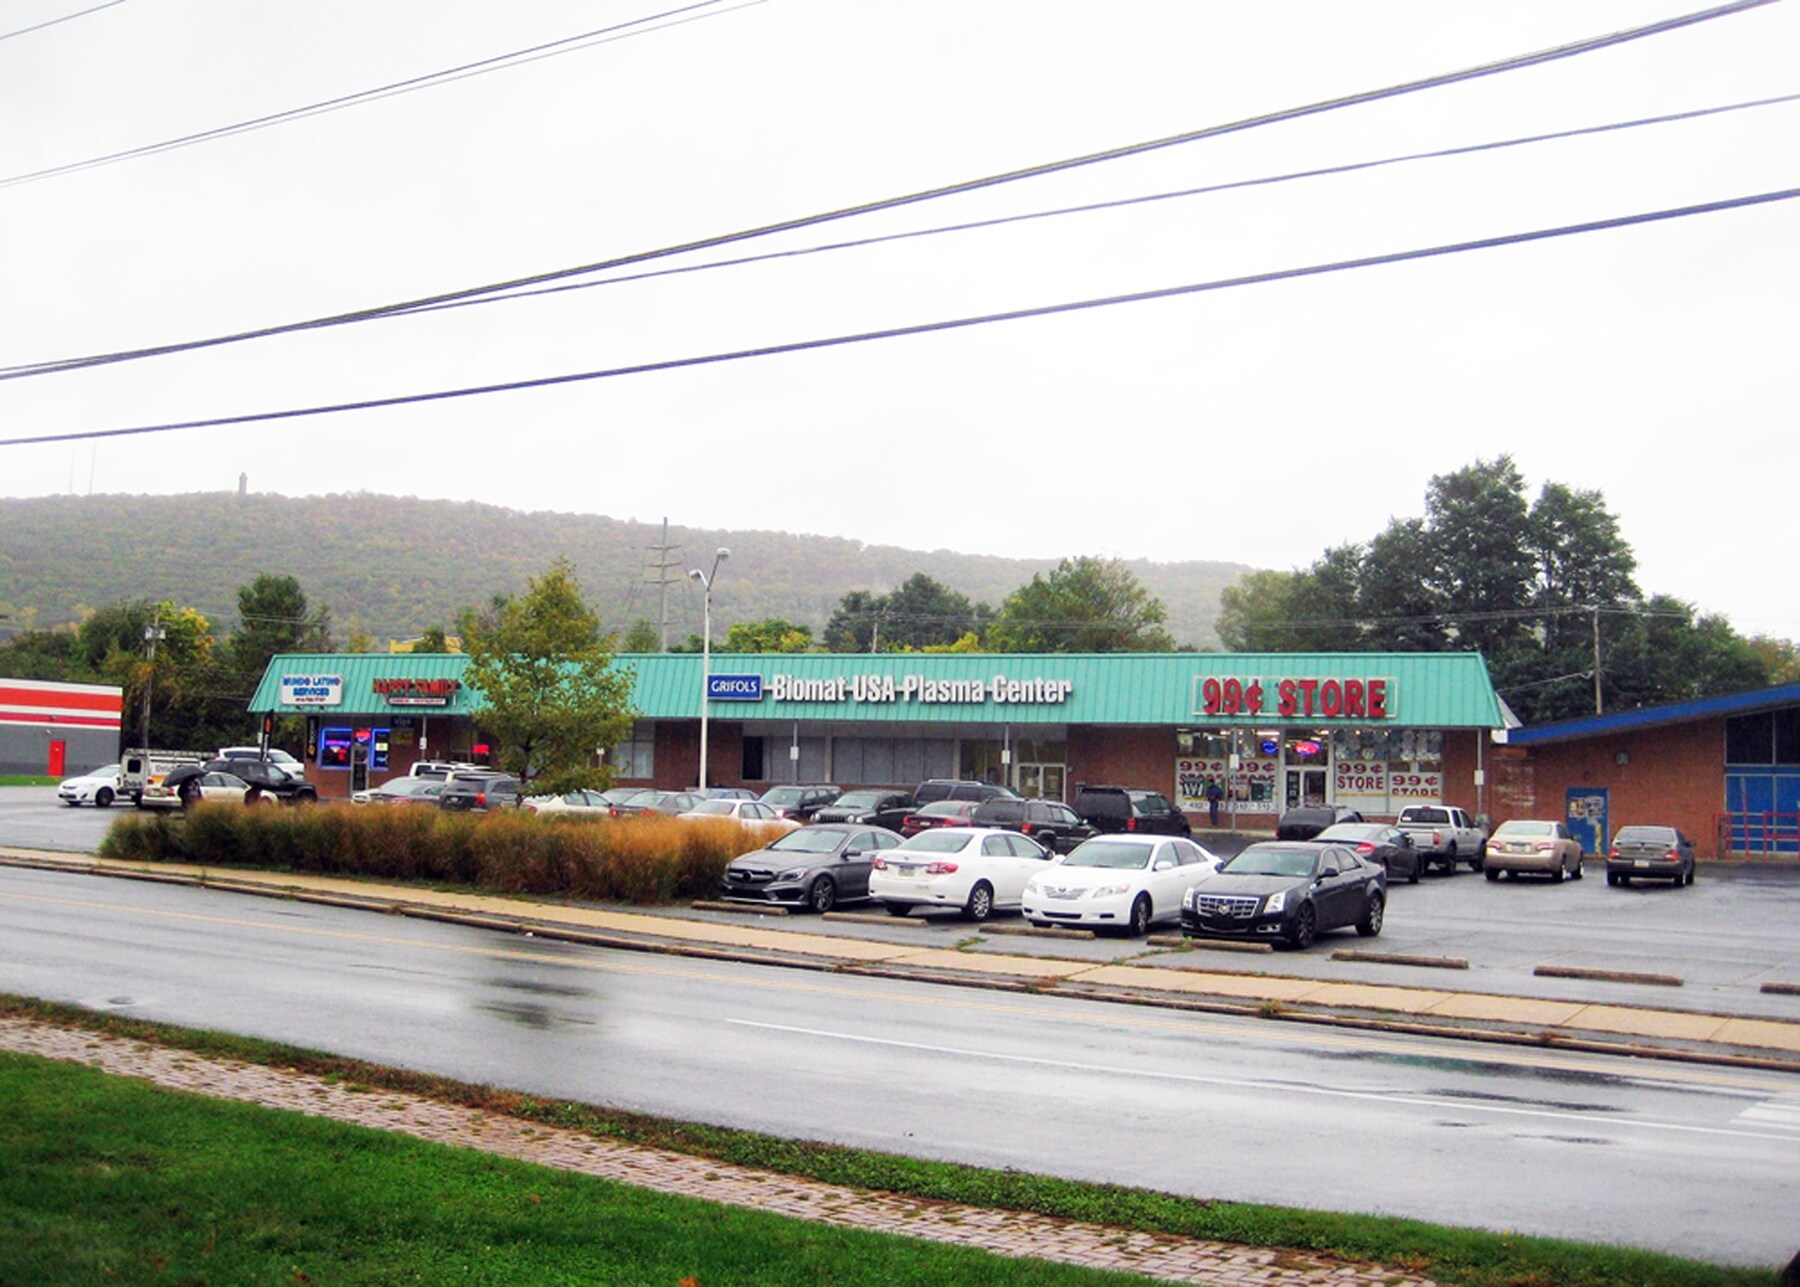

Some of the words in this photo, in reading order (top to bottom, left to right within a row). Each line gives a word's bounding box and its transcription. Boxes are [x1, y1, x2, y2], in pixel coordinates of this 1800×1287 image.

[313, 677, 341, 686] LATINO
[373, 678, 413, 695] HAPPY
[414, 679, 461, 696] FAMILY
[711, 680, 757, 693] GRIFOLS
[773, 674, 846, 702] Biomat
[852, 675, 896, 703] USA
[903, 675, 985, 703] Plasma
[992, 675, 1073, 703] Center
[1203, 678, 1264, 716] 99¢
[1278, 679, 1387, 717] STORE
[1337, 776, 1384, 790] STORE
